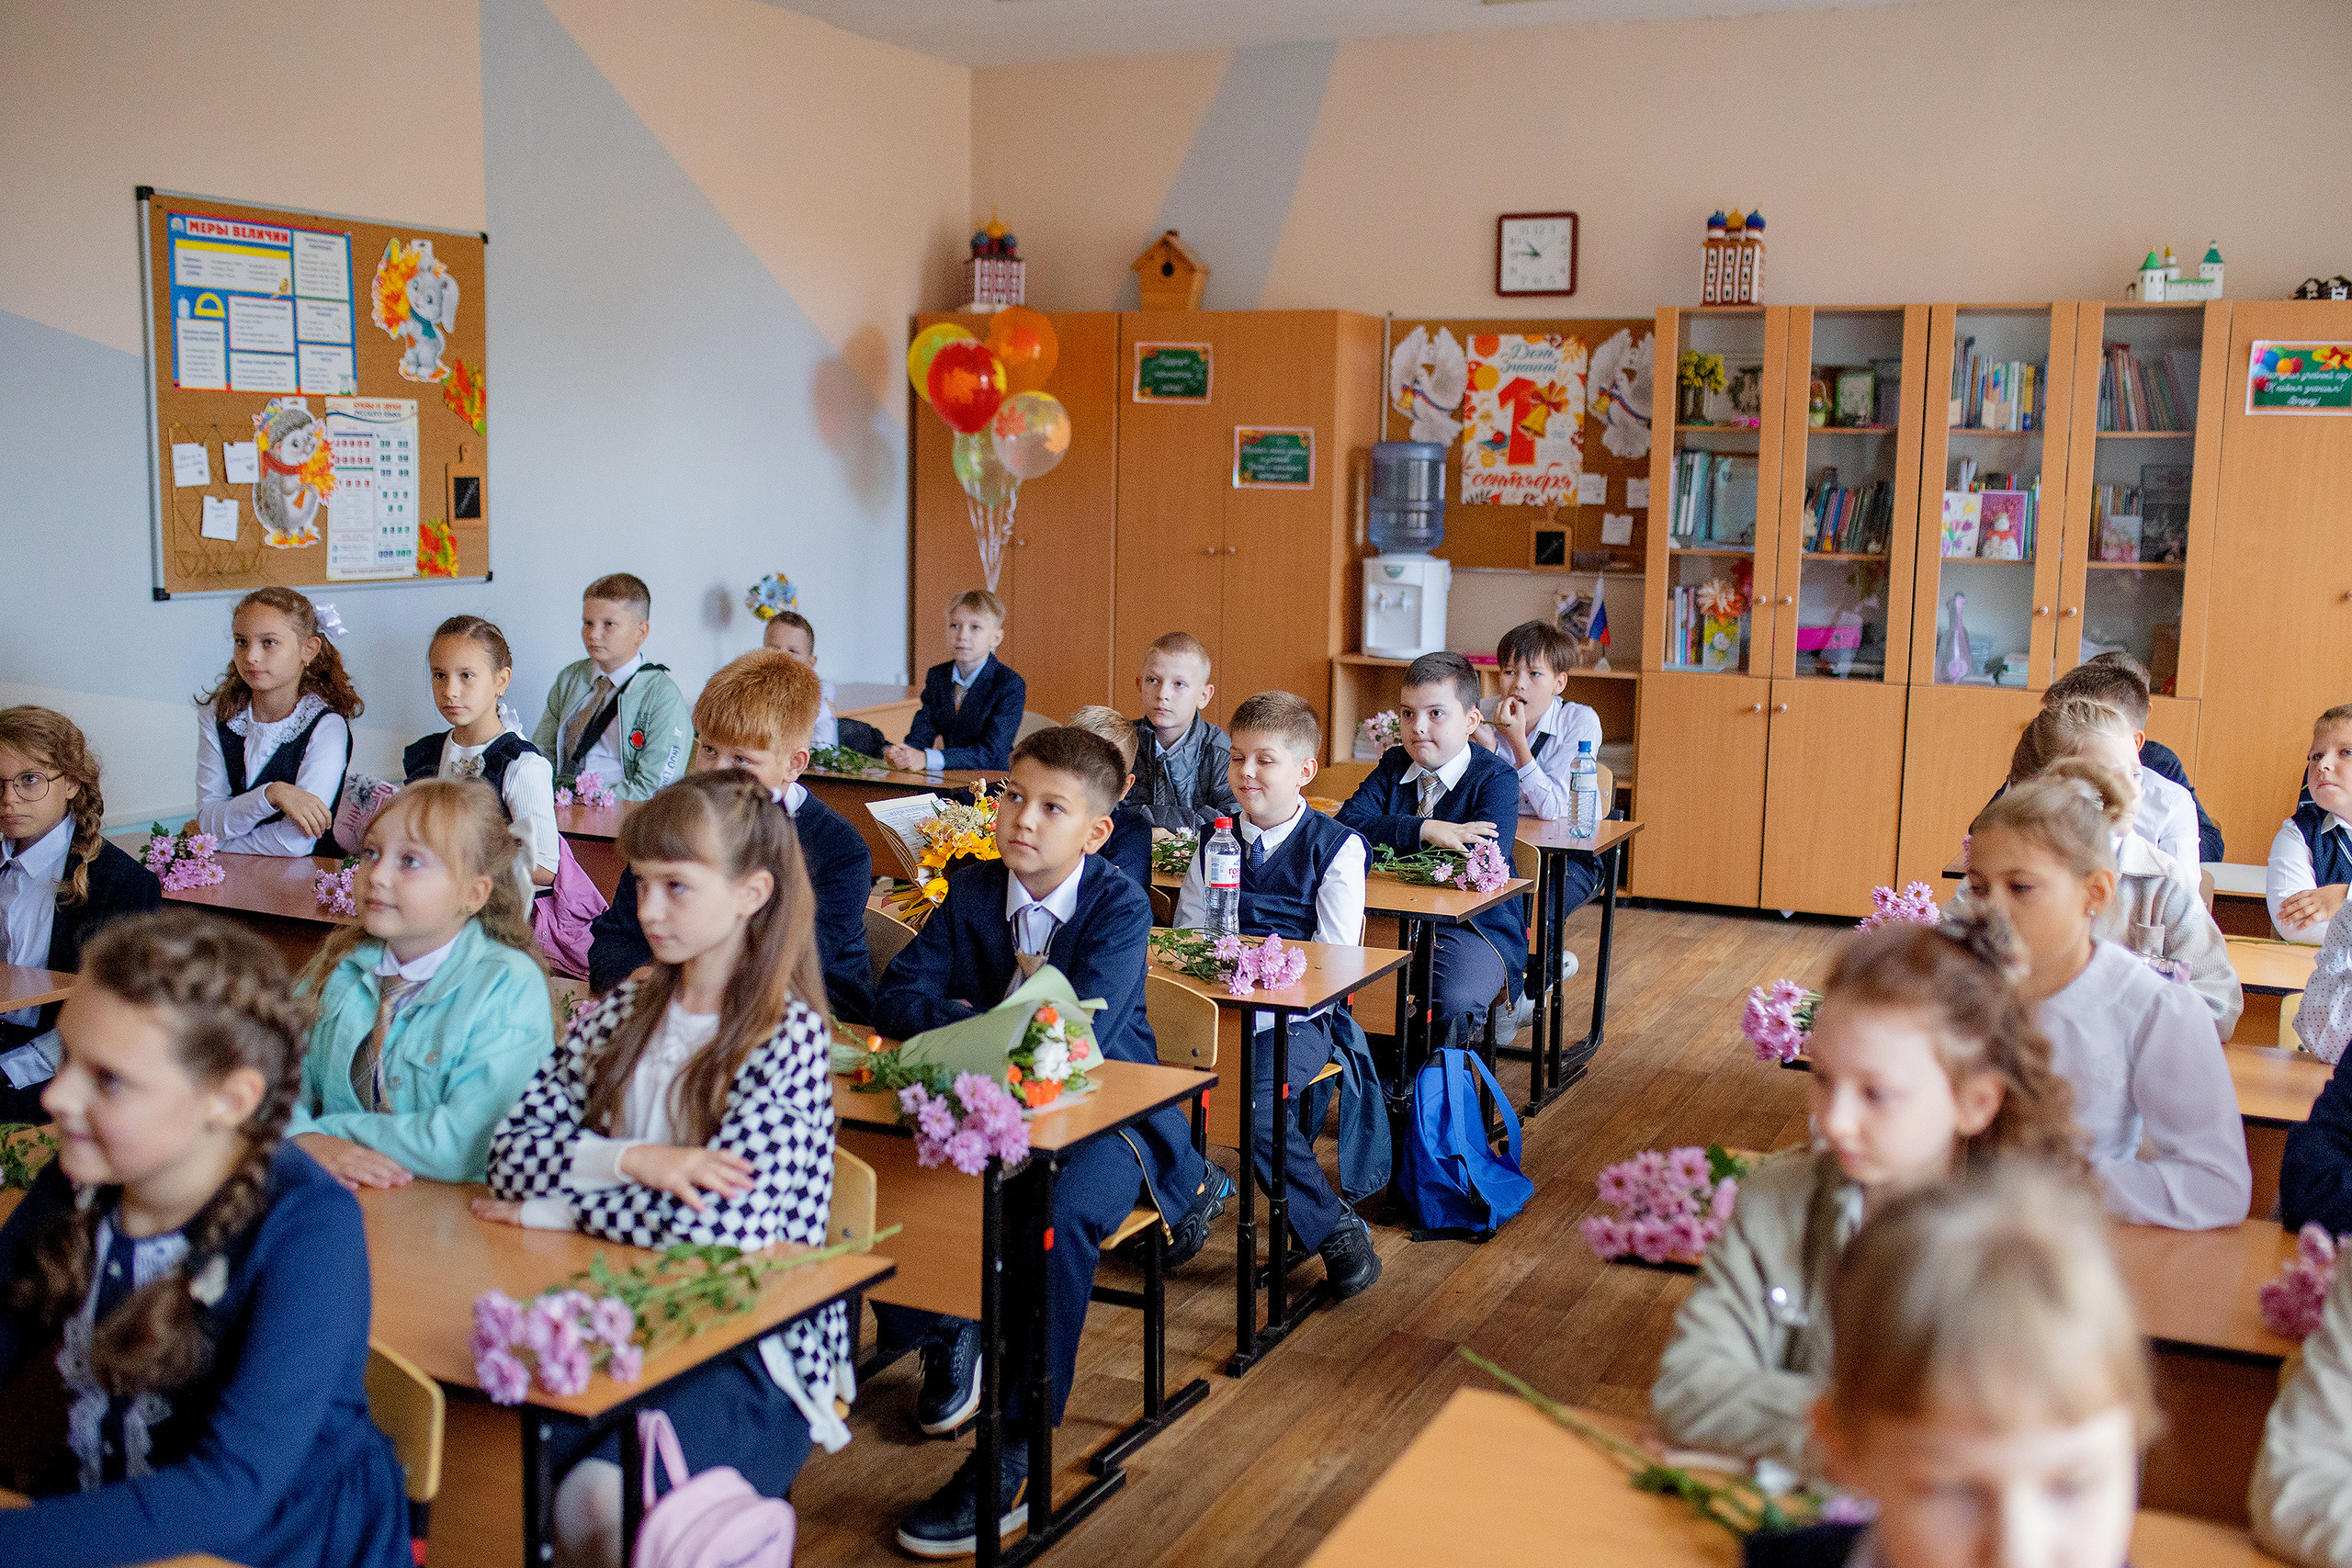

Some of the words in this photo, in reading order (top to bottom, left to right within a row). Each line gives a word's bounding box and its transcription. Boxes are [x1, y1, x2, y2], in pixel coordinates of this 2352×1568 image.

[189, 220, 229, 236] МЕРЫ
[232, 226, 289, 243] ВЕЛИЧИН
[1498, 377, 1538, 466] 1
[1472, 462, 1572, 493] сентября
